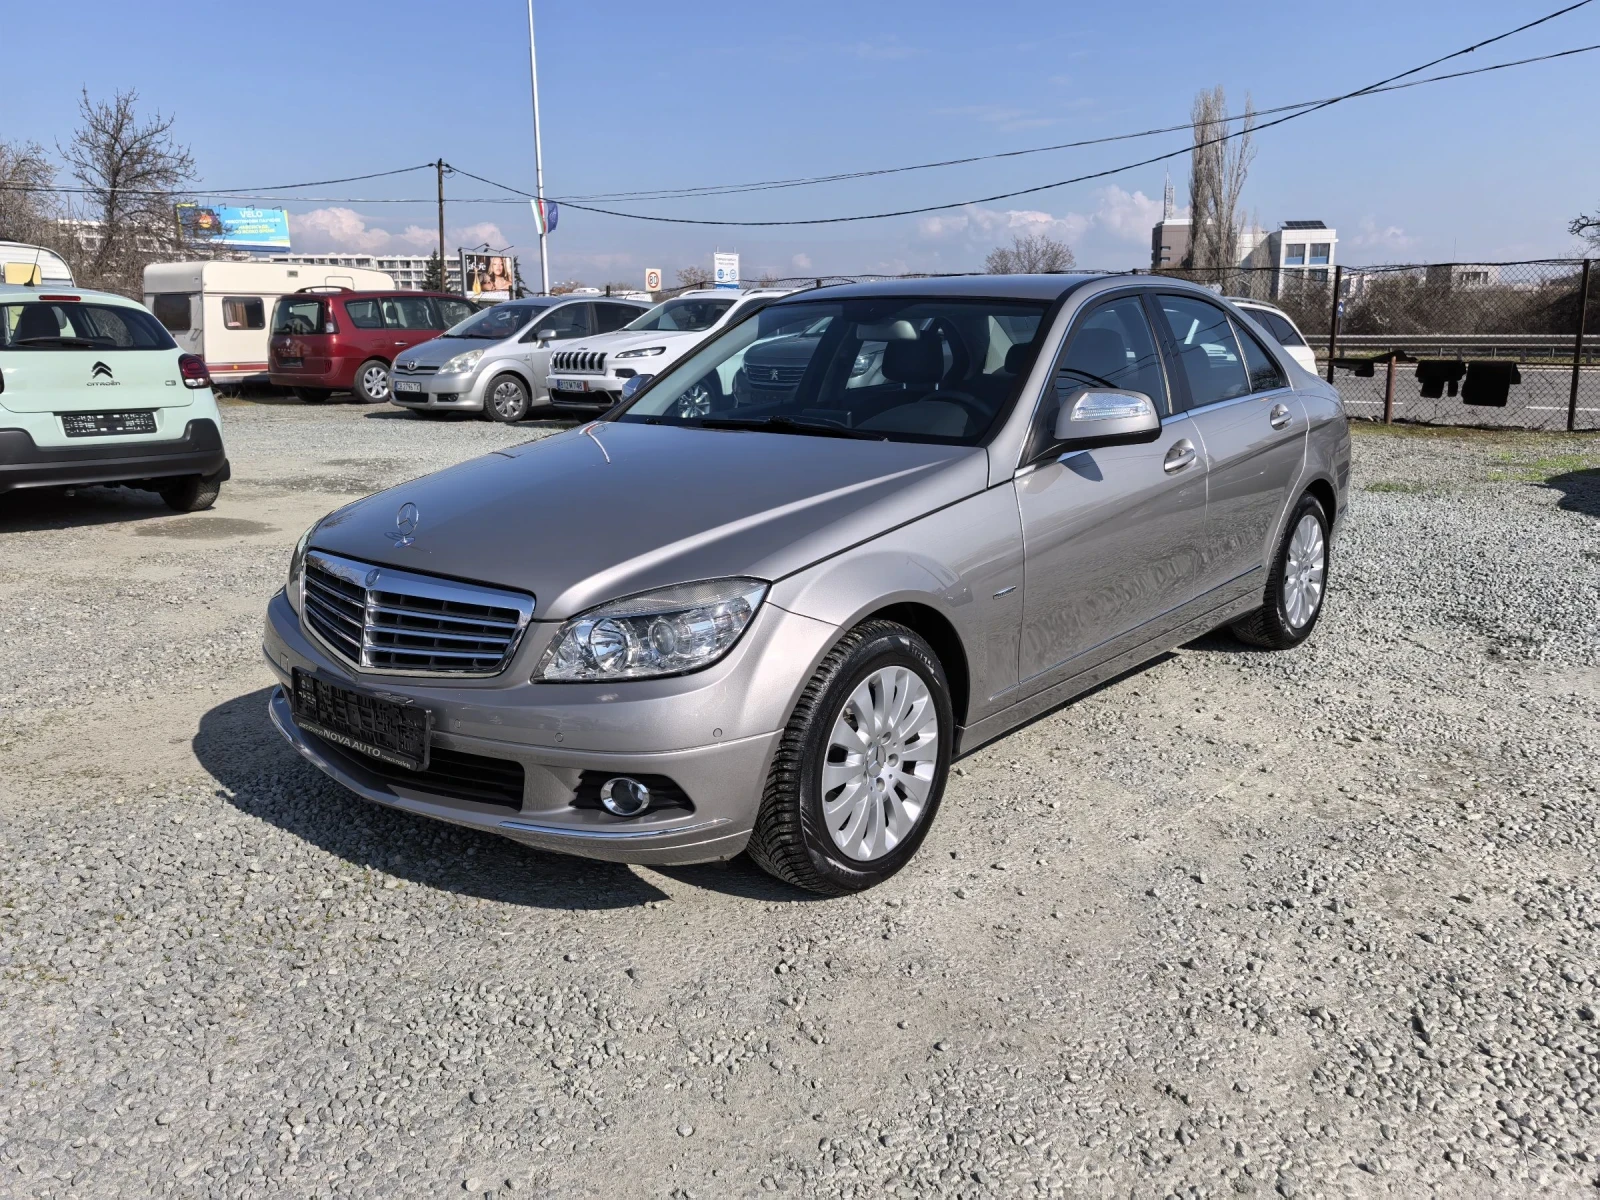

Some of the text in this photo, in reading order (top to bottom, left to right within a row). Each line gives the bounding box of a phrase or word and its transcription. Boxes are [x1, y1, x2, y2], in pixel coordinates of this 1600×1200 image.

[240, 210, 263, 218] VELO
[323, 728, 351, 747] NOVA
[351, 740, 381, 757] AUTO
